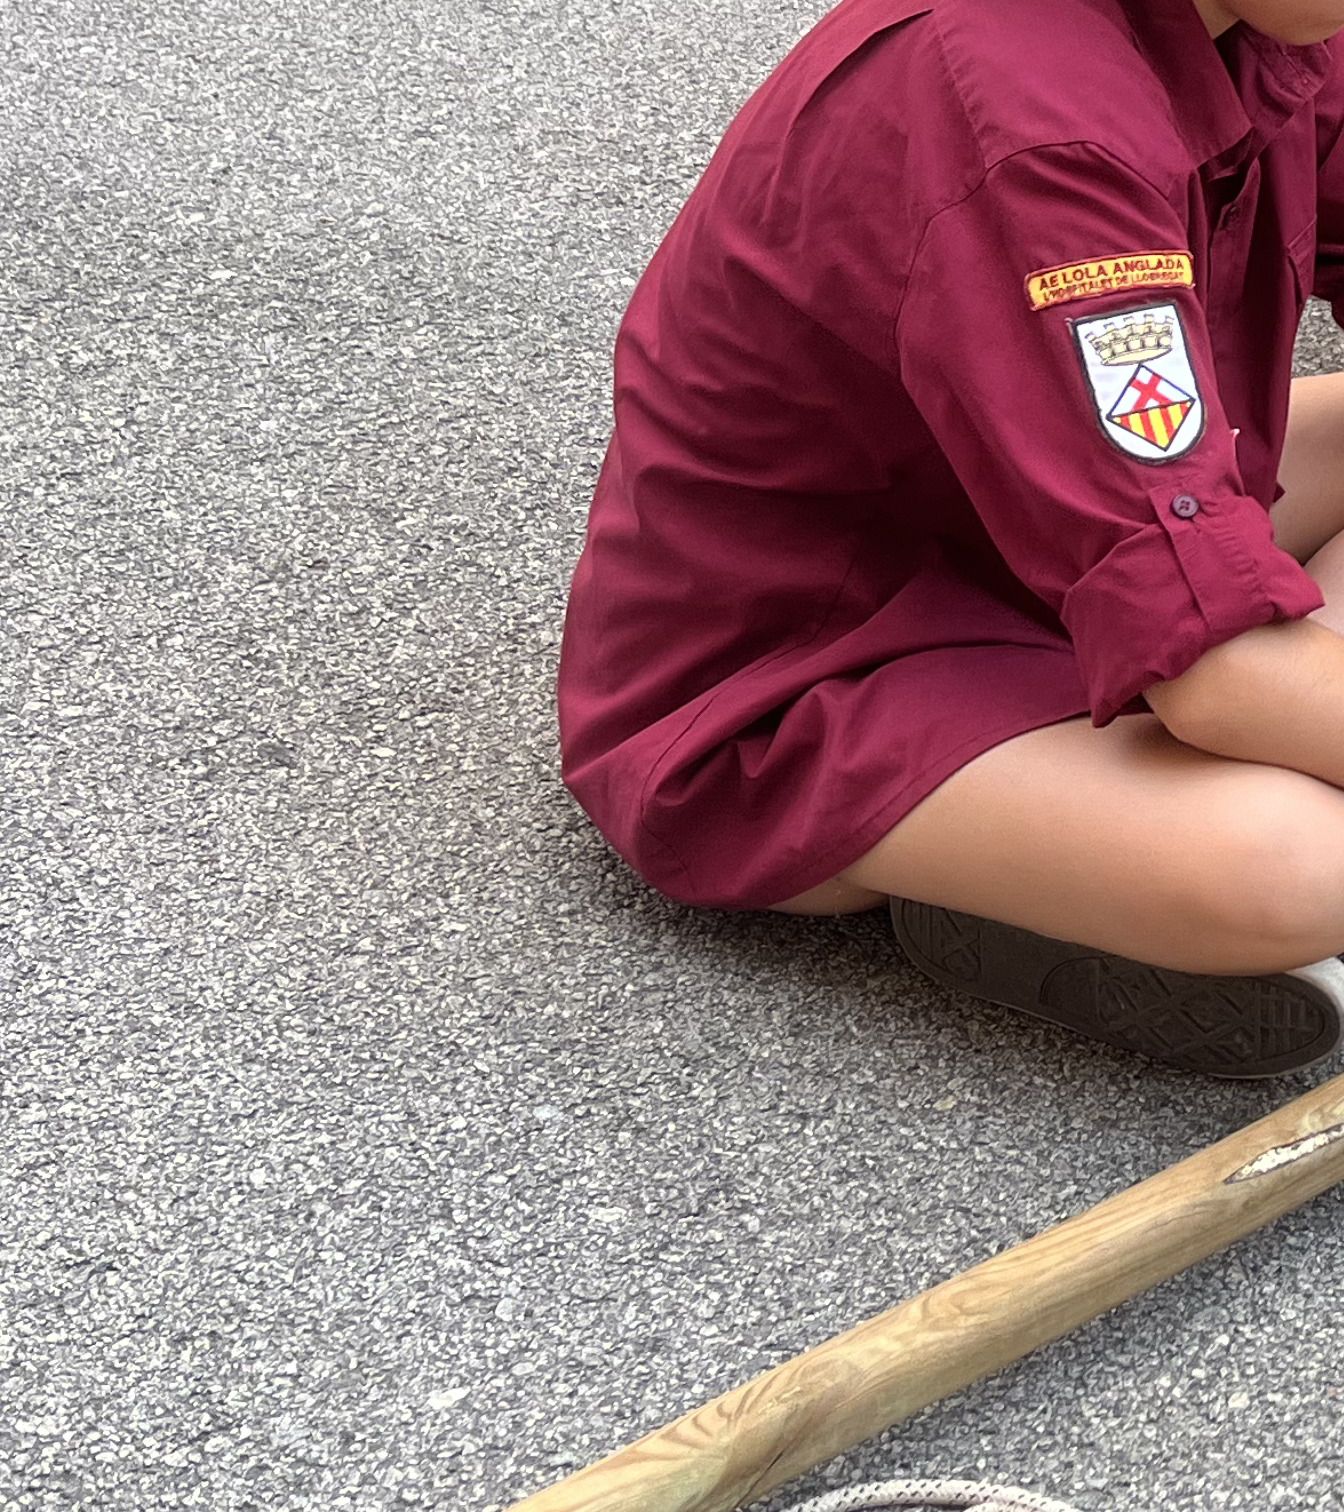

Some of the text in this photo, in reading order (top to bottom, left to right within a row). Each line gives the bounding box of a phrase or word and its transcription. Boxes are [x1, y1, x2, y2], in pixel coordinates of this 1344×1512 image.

[1039, 257, 1185, 290] AE LOLA ANGLADA
